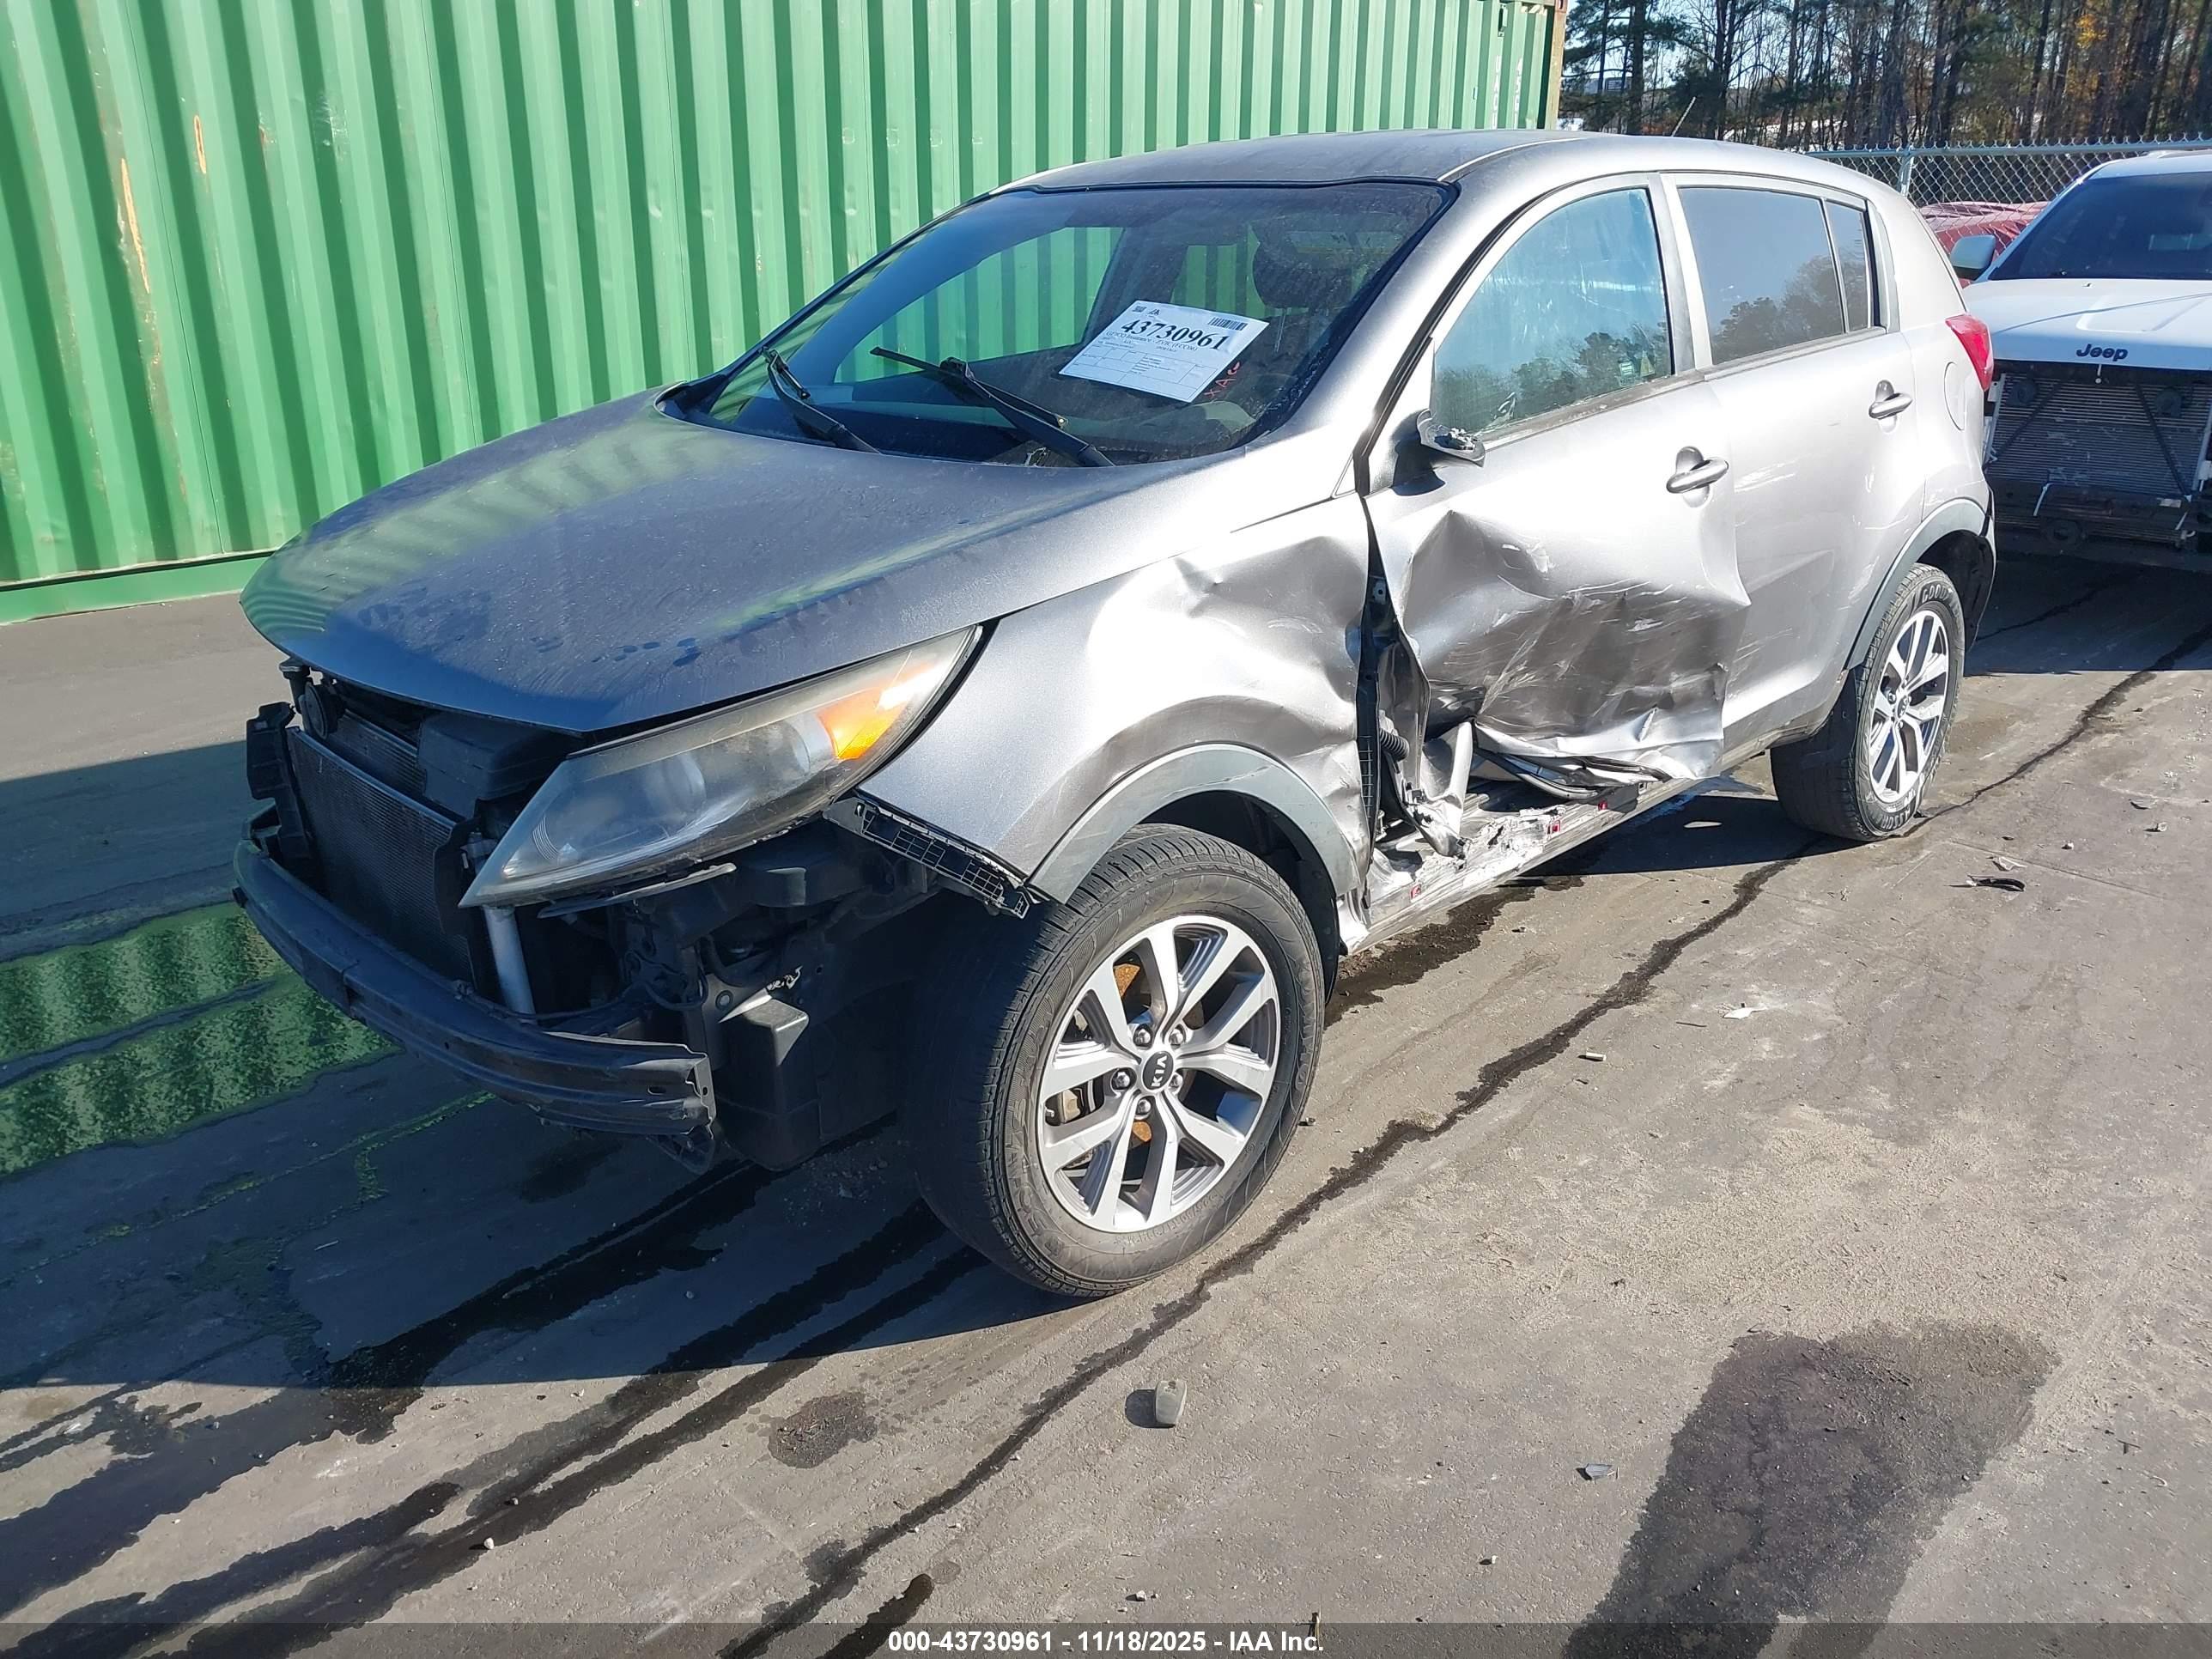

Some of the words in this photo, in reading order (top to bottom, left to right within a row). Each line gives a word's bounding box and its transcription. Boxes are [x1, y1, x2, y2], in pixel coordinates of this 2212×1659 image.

[1121, 319, 1230, 350] 43730961
[2076, 343, 2128, 362] Jeep
[1152, 1055, 1167, 1086] KIA
